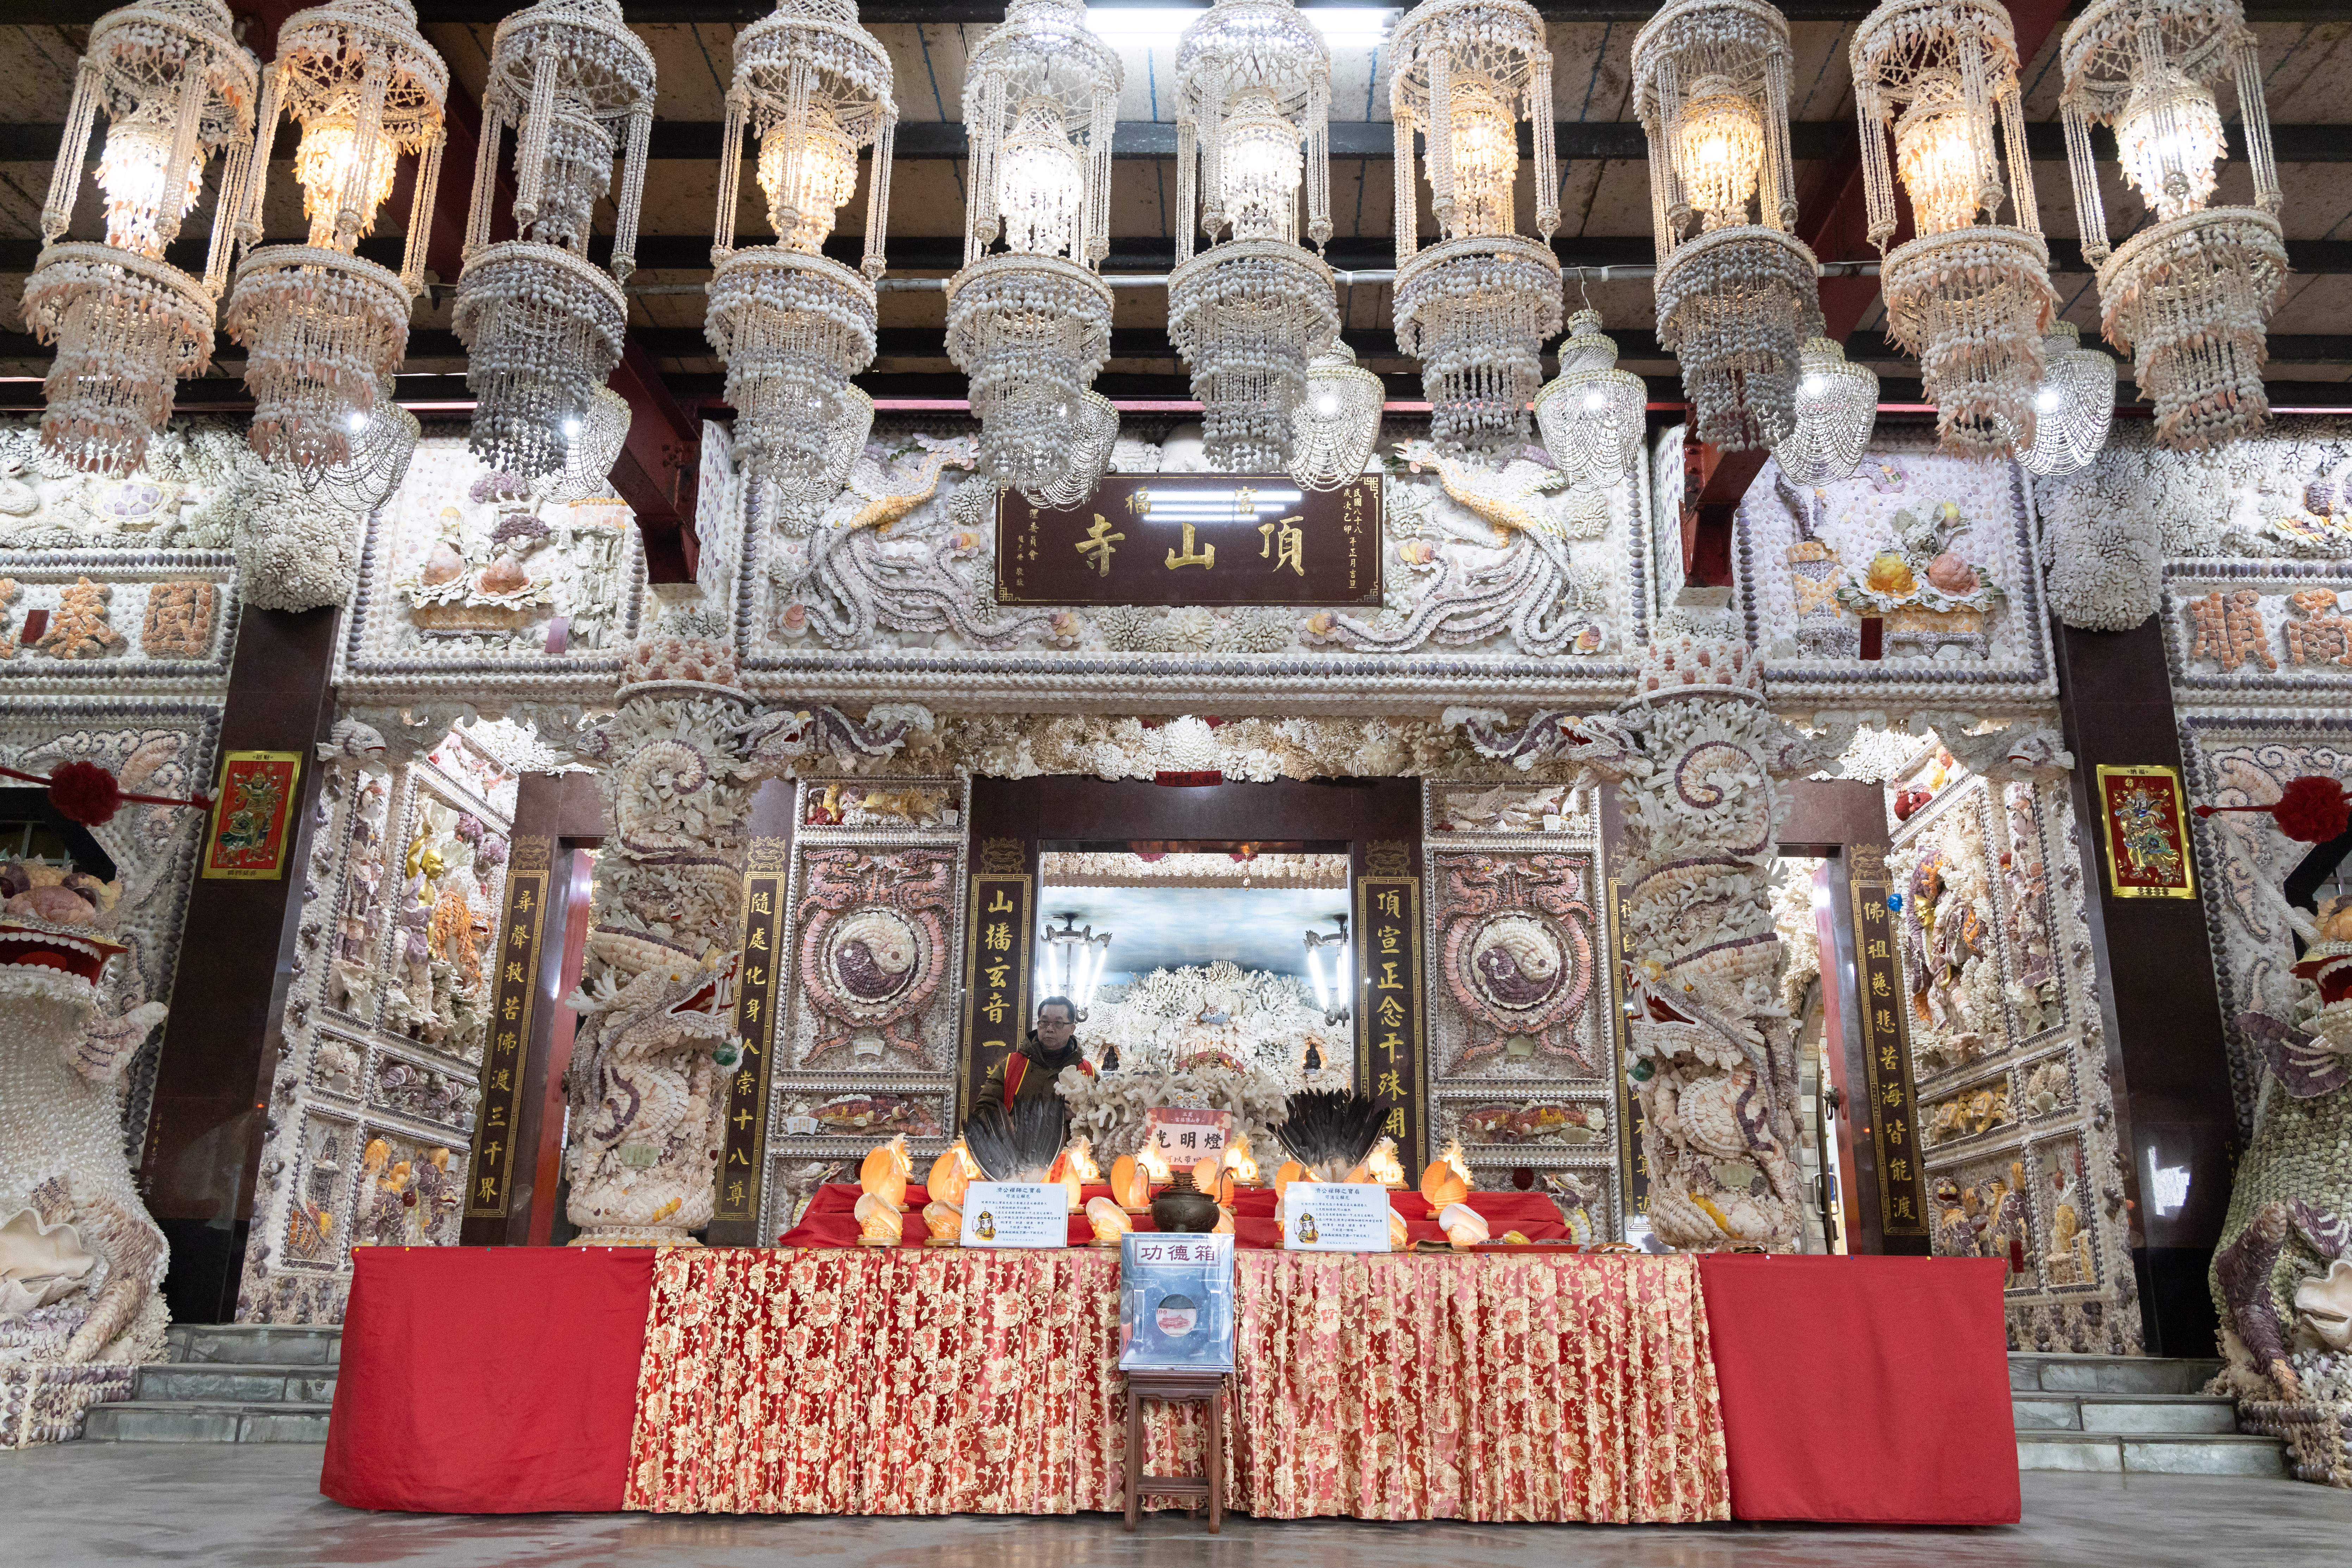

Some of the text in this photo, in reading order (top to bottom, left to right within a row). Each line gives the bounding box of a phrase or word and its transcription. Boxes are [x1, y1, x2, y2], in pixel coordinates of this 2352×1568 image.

[1074, 513, 1304, 577] 頂山寺
[981, 890, 1013, 1088] 山播玄音一
[1141, 1244, 1215, 1262] 功德箱
